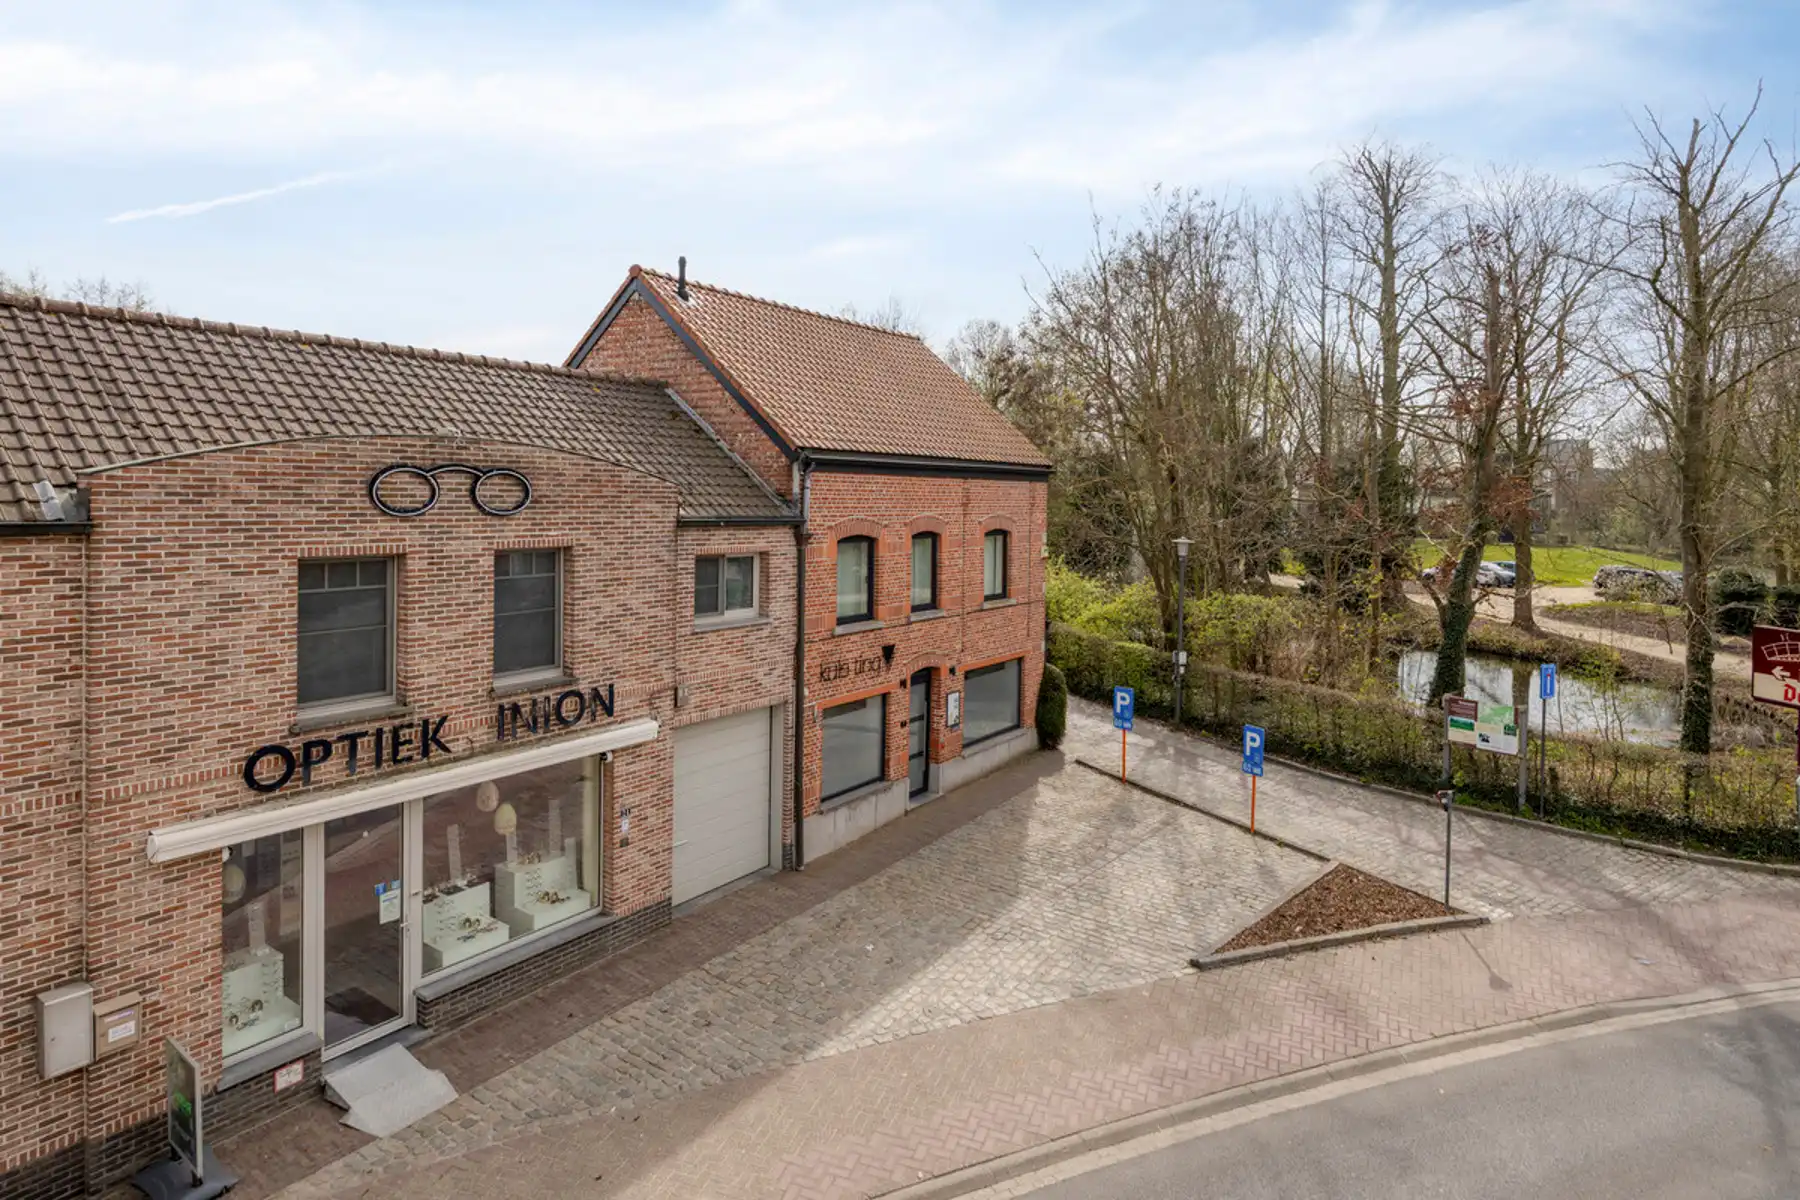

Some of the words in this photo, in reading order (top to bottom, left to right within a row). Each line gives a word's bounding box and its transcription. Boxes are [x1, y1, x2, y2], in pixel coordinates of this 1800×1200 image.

[1116, 691, 1130, 714] P
[243, 715, 452, 792] OPTIEK
[498, 684, 614, 740] INION
[1246, 731, 1260, 756] P
